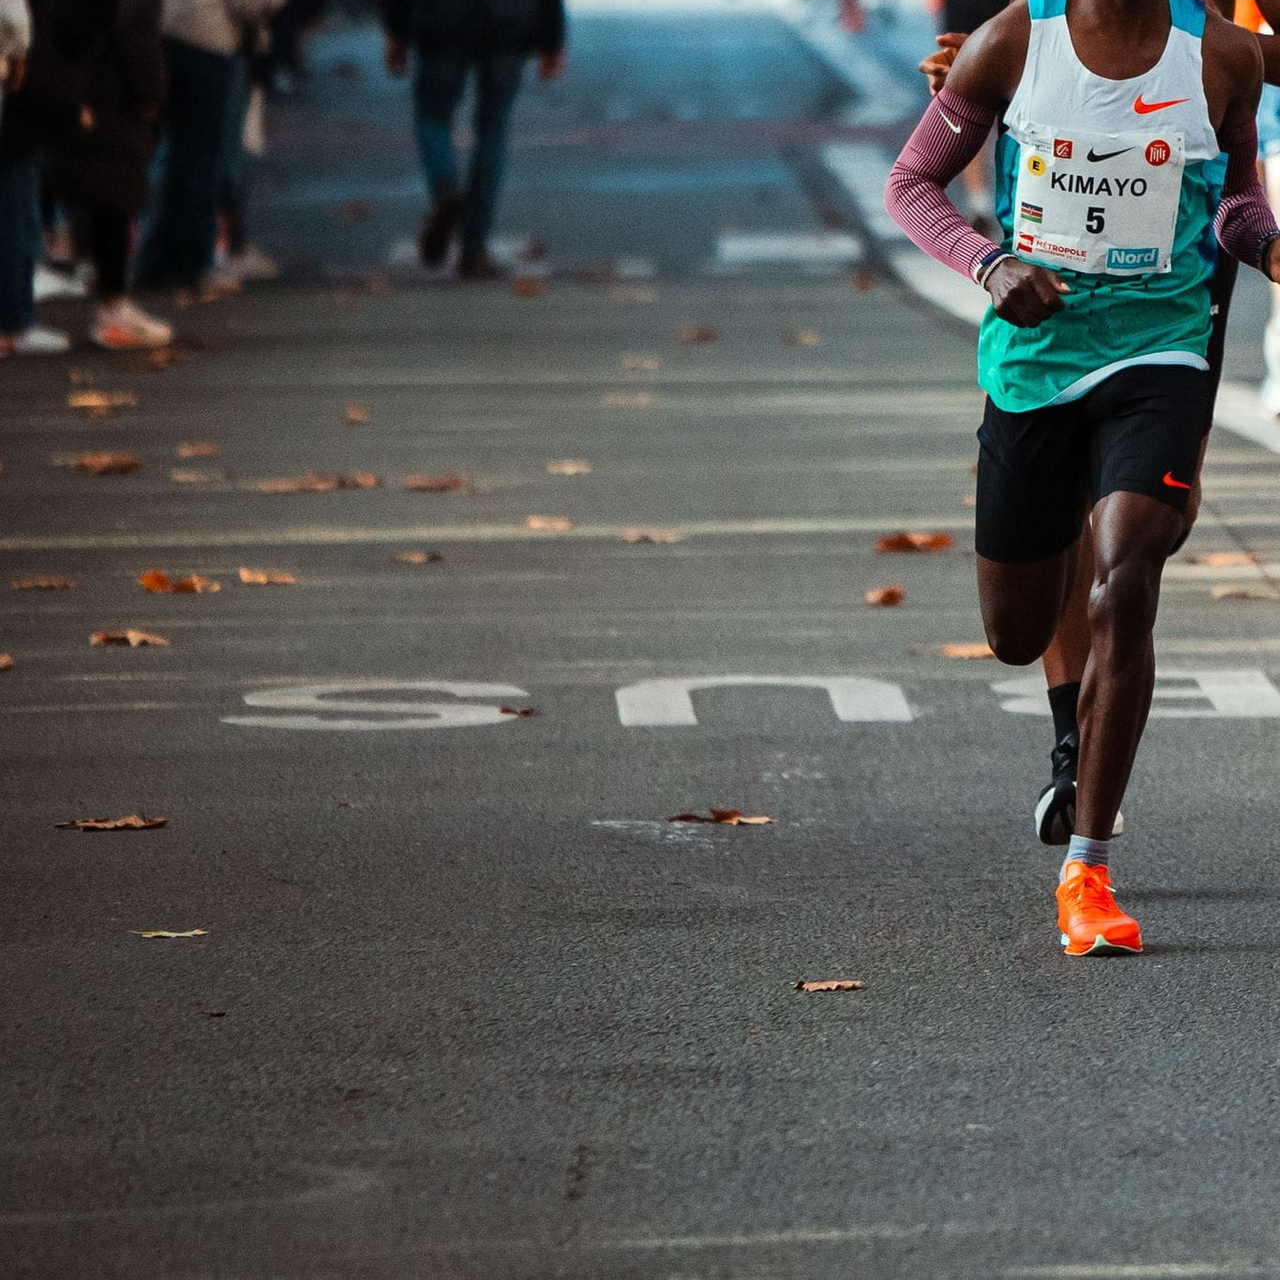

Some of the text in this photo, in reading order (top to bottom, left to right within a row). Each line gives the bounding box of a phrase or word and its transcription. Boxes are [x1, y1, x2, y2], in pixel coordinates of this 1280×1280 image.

[1032, 161, 1040, 171] E
[1051, 173, 1148, 197] KIMAYO
[1086, 207, 1106, 235] 5
[1111, 249, 1156, 265] Nord
